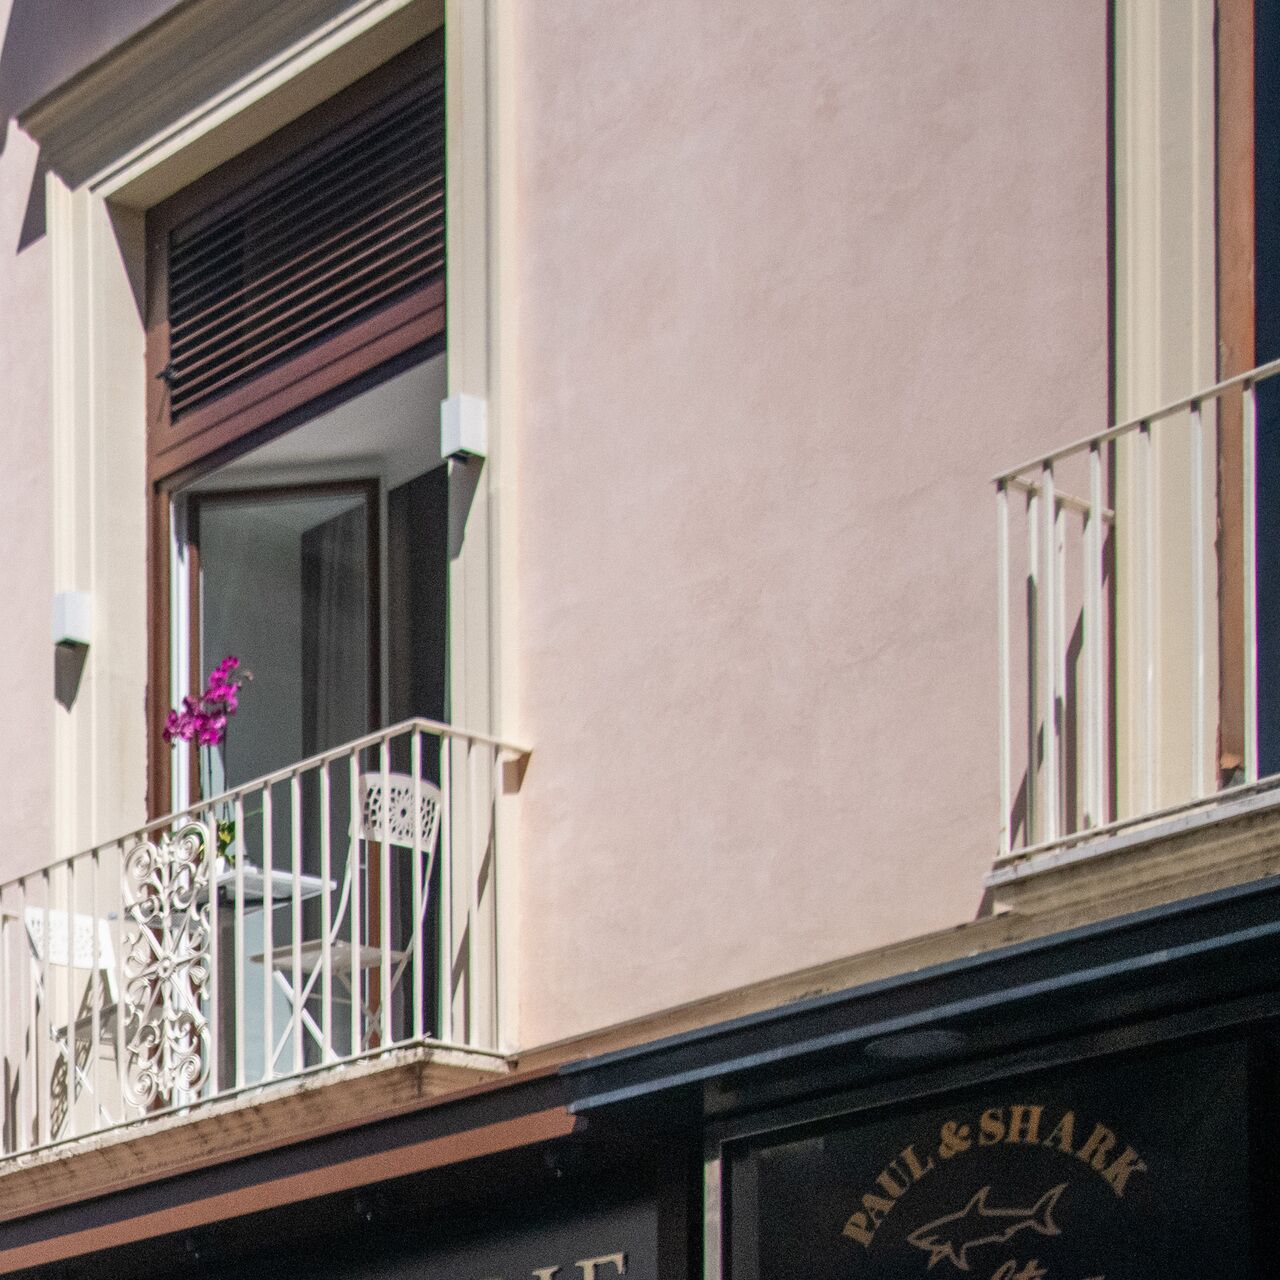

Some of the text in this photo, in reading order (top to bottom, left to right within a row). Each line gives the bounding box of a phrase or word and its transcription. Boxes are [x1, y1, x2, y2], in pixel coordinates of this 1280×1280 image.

[843, 1104, 1149, 1249] PAUL & SHARK
